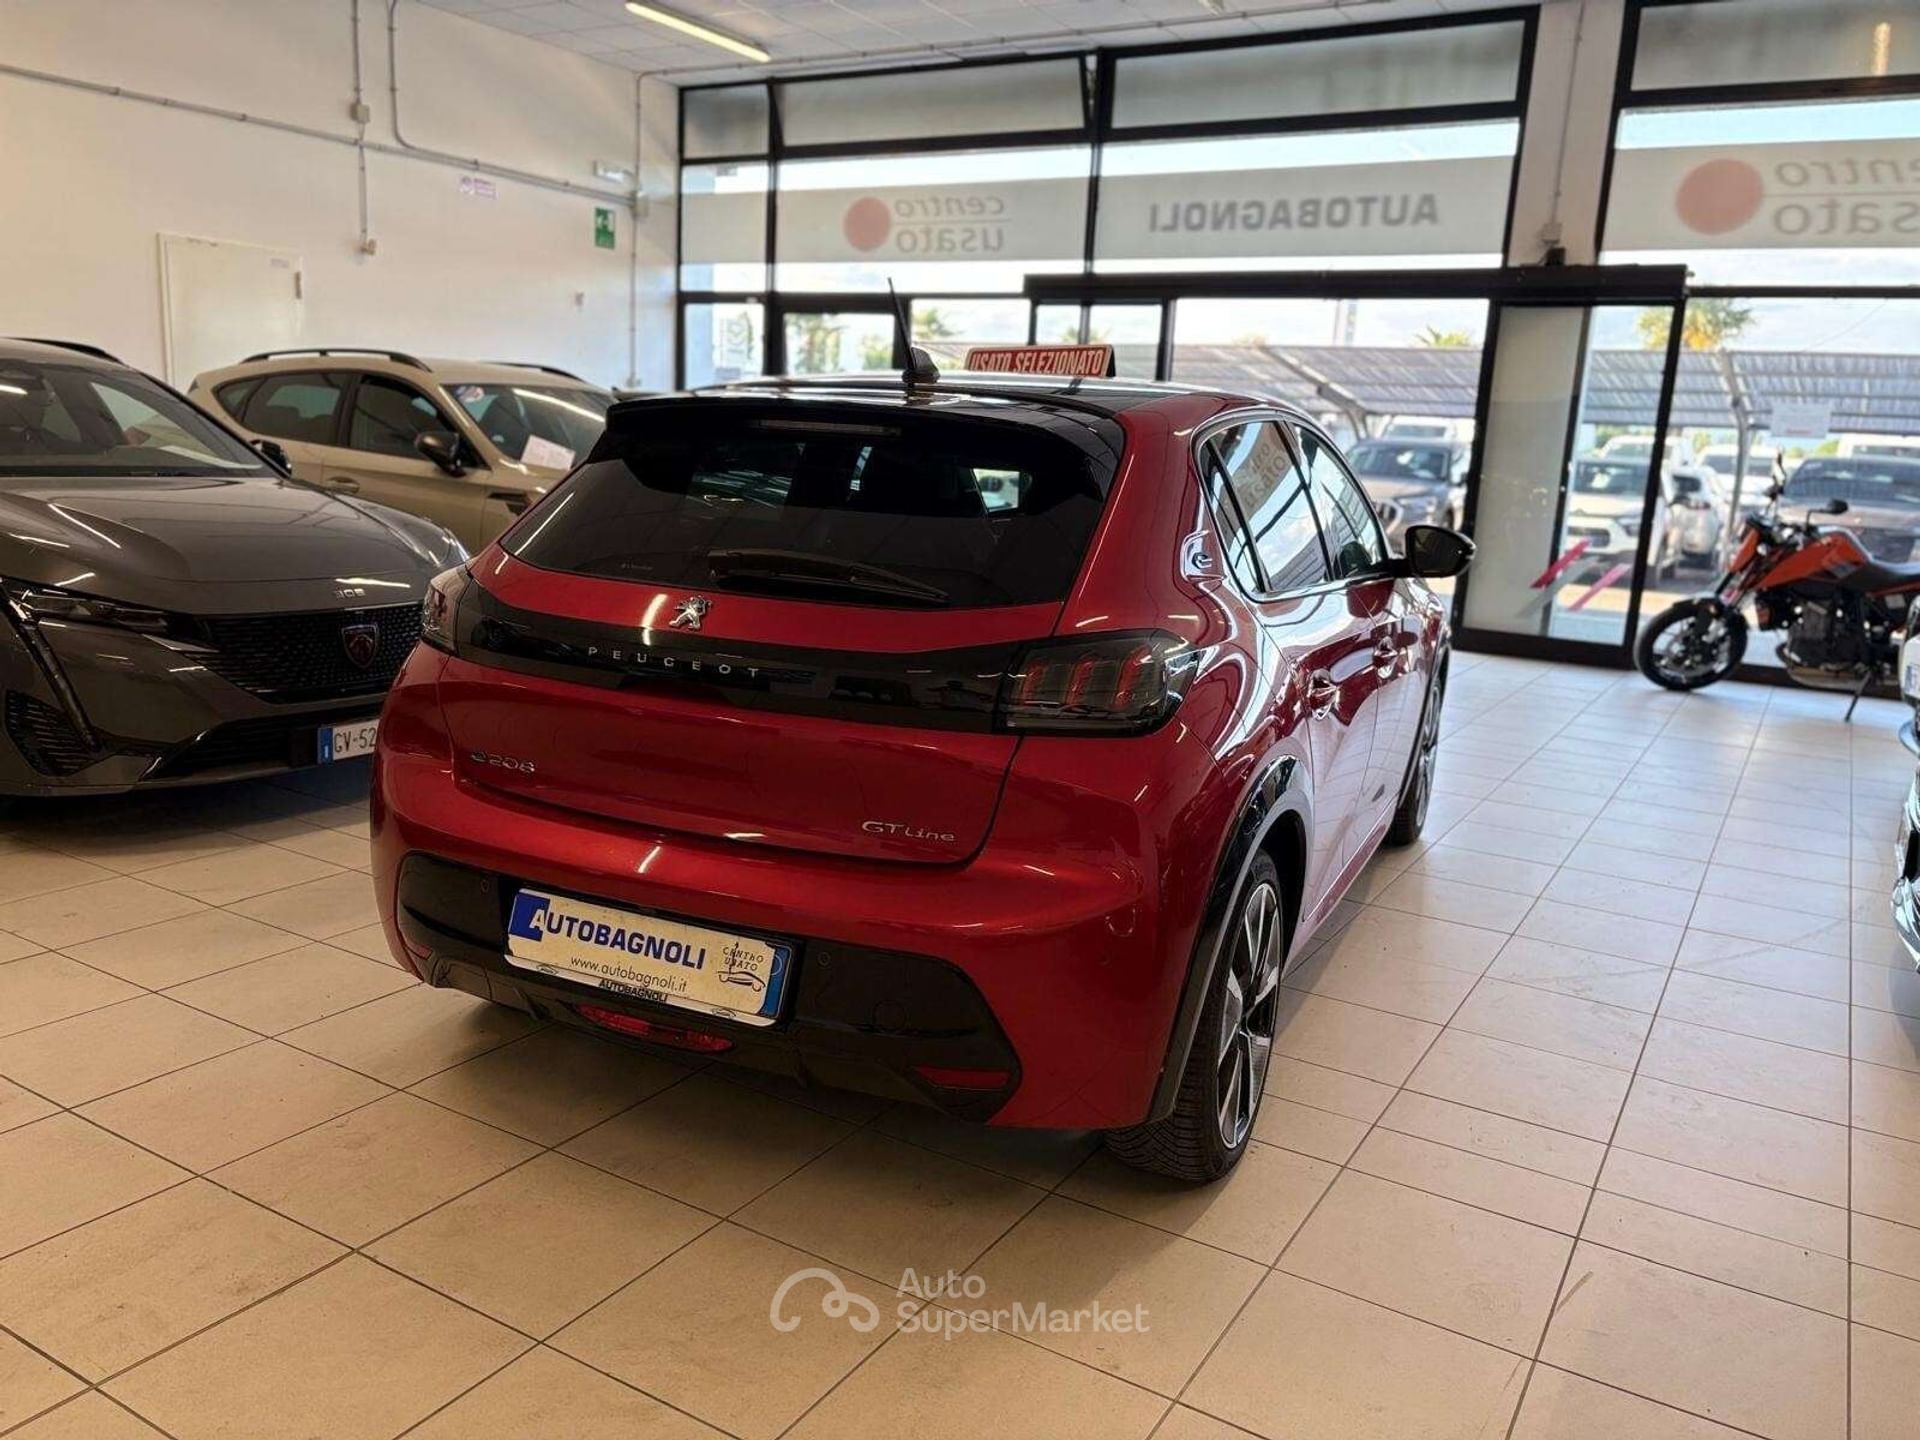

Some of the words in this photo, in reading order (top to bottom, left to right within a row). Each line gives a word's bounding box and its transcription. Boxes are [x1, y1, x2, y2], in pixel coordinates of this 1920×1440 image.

[970, 352, 1012, 372] USATO
[1013, 350, 1105, 375] SELEZIONATO
[587, 646, 759, 678] PEUGEOT
[530, 908, 706, 970] AUTOBAGNOLI
[570, 954, 688, 993] www.autobagnoli.it
[599, 979, 669, 1002] AUTOBAGNOLI
